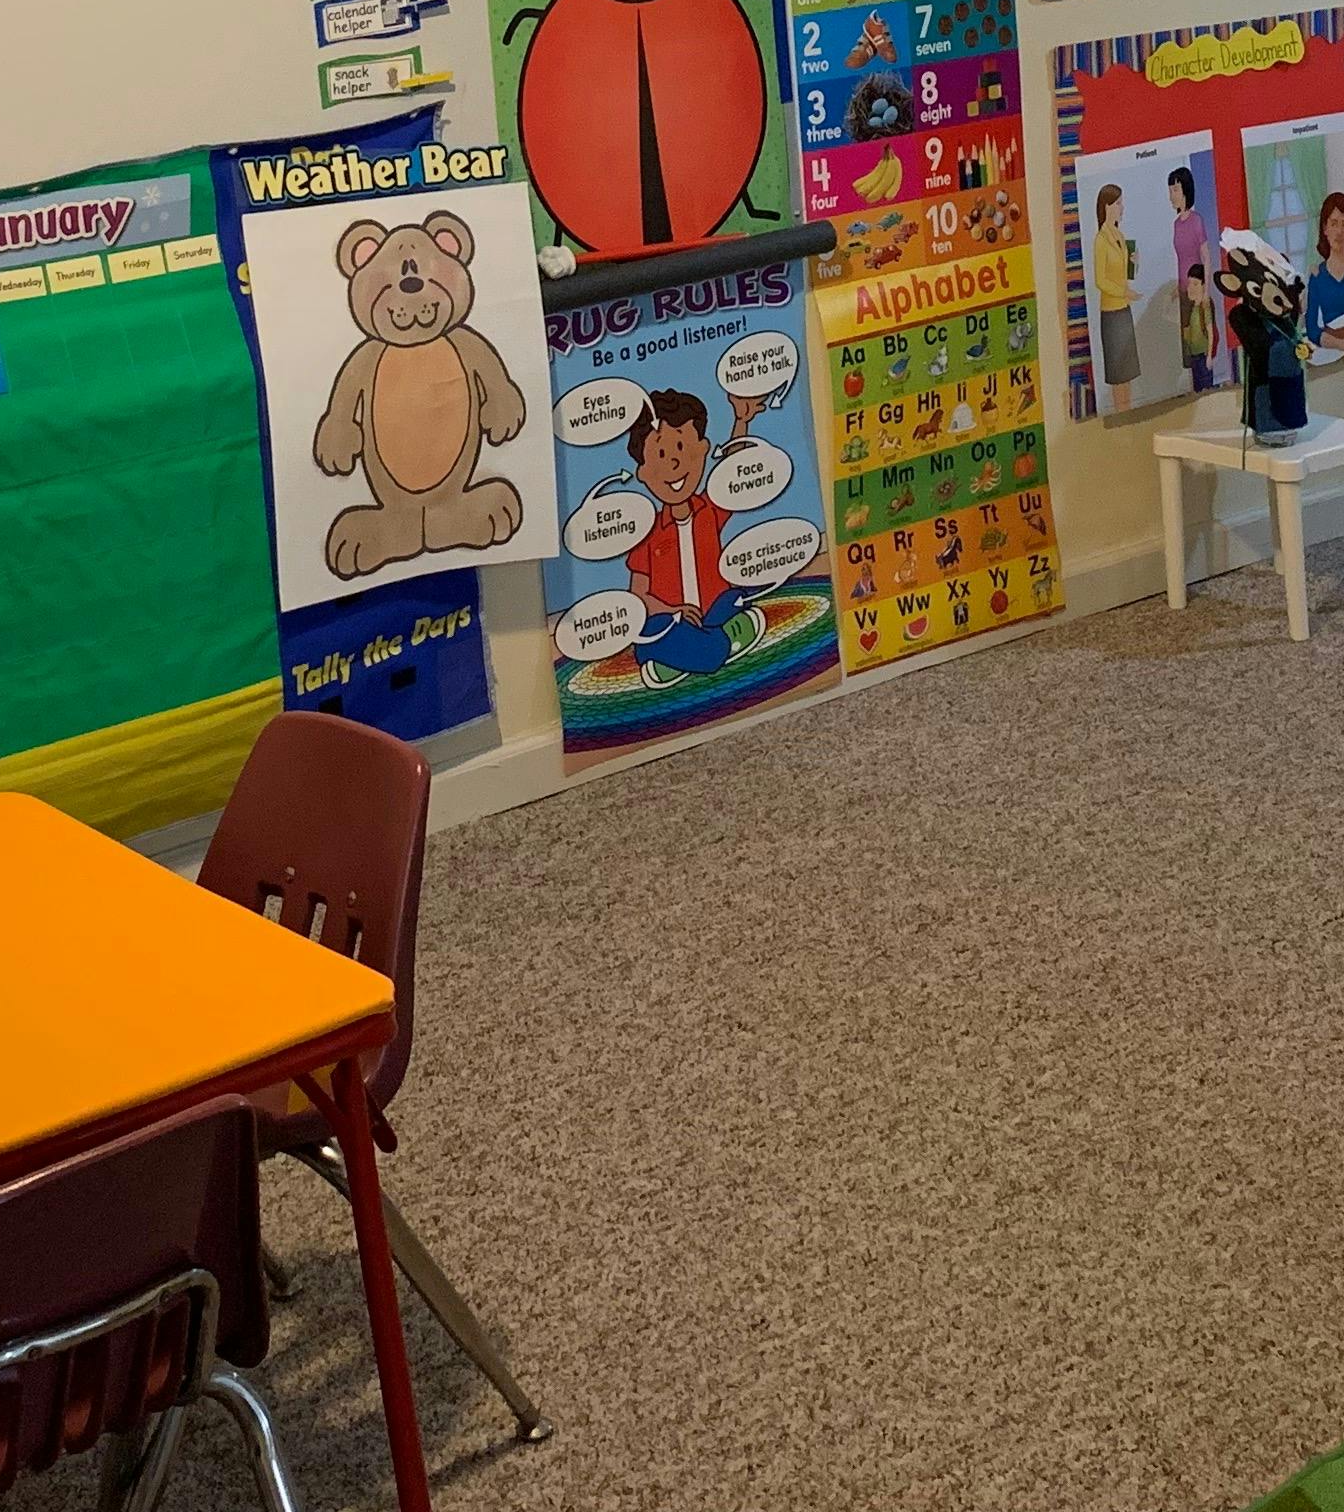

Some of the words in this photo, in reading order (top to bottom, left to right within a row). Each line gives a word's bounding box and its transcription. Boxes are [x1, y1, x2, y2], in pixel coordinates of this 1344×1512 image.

[328, 4, 378, 20] calendar
[334, 19, 372, 34] helper
[1150, 48, 1215, 82] Character
[1220, 35, 1300, 75] Development
[335, 66, 369, 80] snack
[333, 80, 371, 94] helper
[242, 156, 411, 204] Weather
[421, 143, 508, 187] Bear
[123, 258, 150, 272] Friday
[173, 247, 213, 262] Saturday
[56, 267, 95, 282] Thursday
[856, 257, 1010, 324] Alphabet
[545, 303, 642, 359] RUG
[656, 264, 791, 320] RULES
[593, 350, 614, 368] Be
[621, 348, 630, 361] a
[636, 332, 678, 362] good
[683, 316, 748, 347] listener!
[730, 350, 759, 368] Raise
[760, 345, 785, 363] your
[726, 367, 754, 384] hand
[757, 364, 768, 376] to
[771, 356, 793, 374] talk.
[583, 393, 611, 410] Eyes
[570, 405, 626, 428] watching
[737, 462, 764, 477] Face
[729, 472, 774, 496] forward
[596, 507, 622, 523] Ears
[584, 519, 636, 543] listening
[726, 550, 754, 570] Legs
[756, 532, 813, 556] criss-cross
[741, 550, 806, 578] applesauce
[574, 611, 609, 633] Hands
[612, 607, 628, 622] in
[578, 627, 607, 649] your
[610, 621, 629, 643] lap
[292, 652, 353, 697] Tally
[364, 634, 403, 667] the
[412, 606, 470, 647] Days
